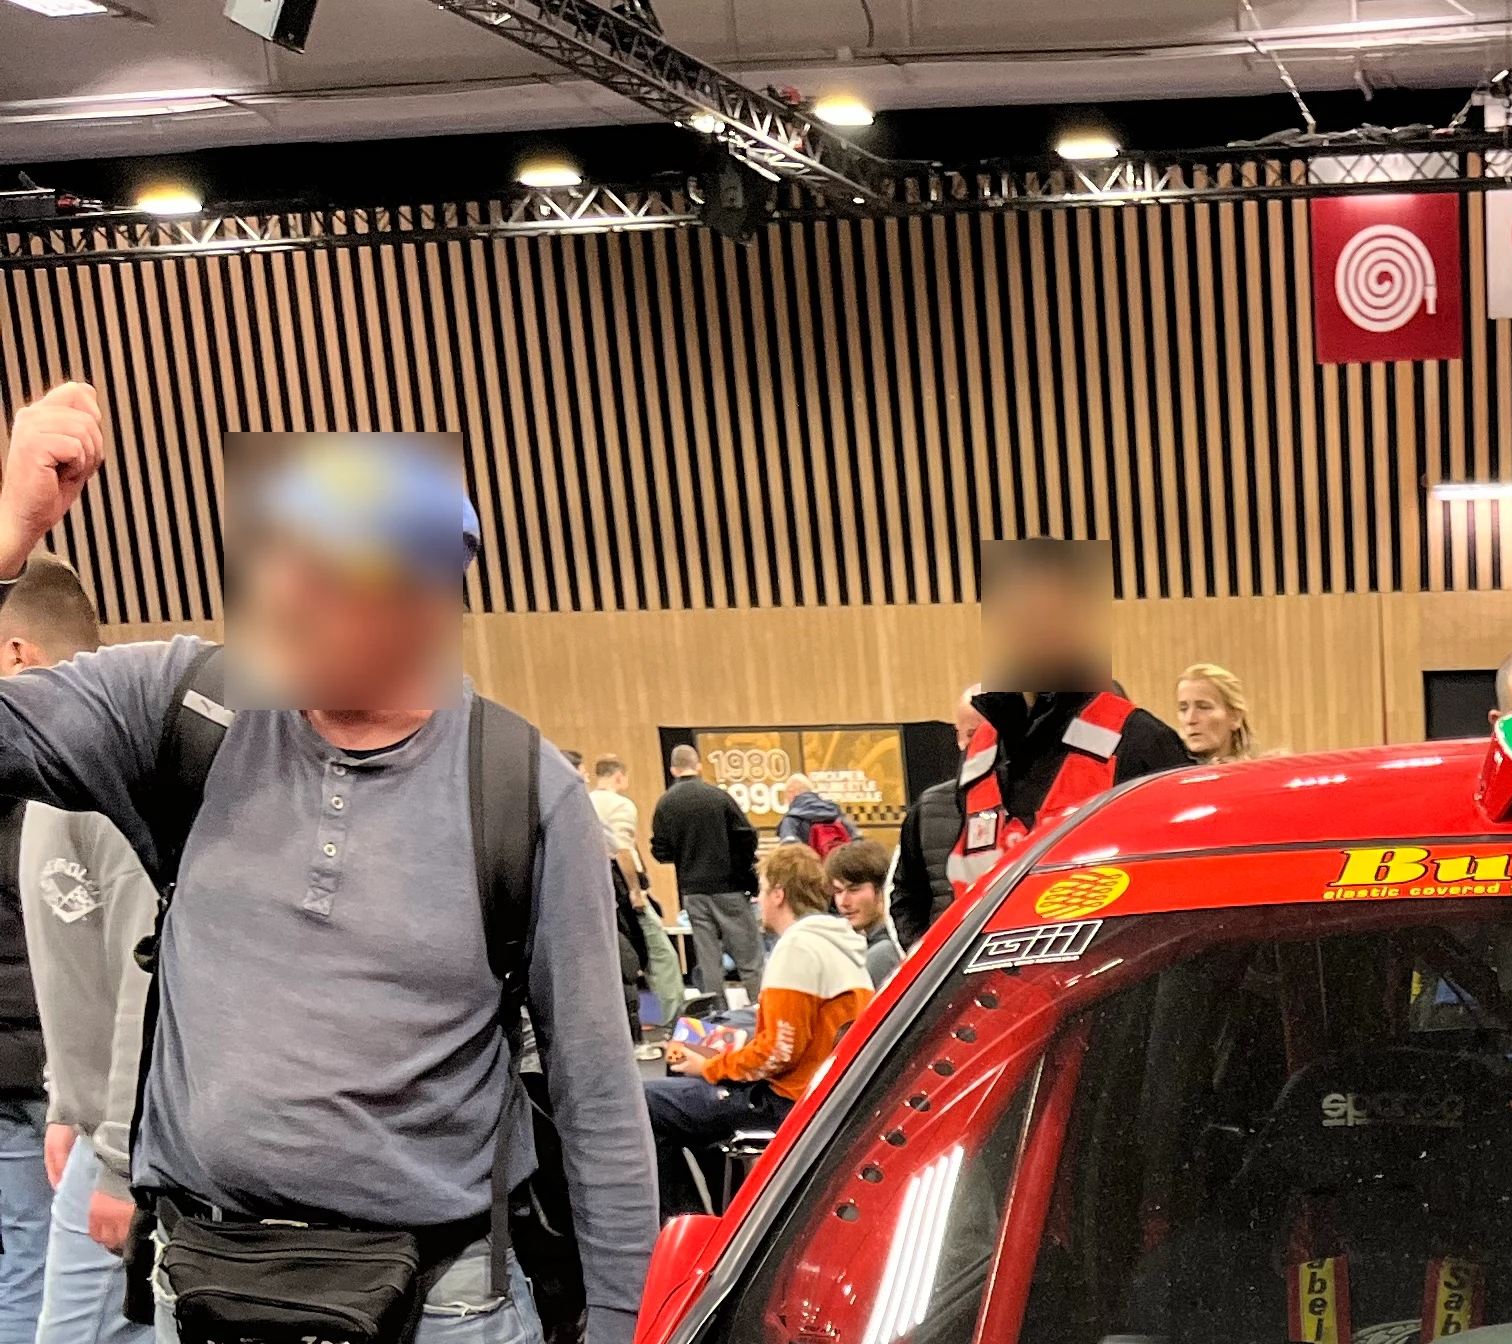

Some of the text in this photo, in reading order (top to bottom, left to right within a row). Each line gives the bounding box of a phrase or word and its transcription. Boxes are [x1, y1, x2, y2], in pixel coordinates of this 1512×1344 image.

[707, 748, 791, 782] 1980
[718, 782, 789, 815] 990
[1323, 886, 1400, 901] elastic
[1409, 882, 1501, 896] covered
